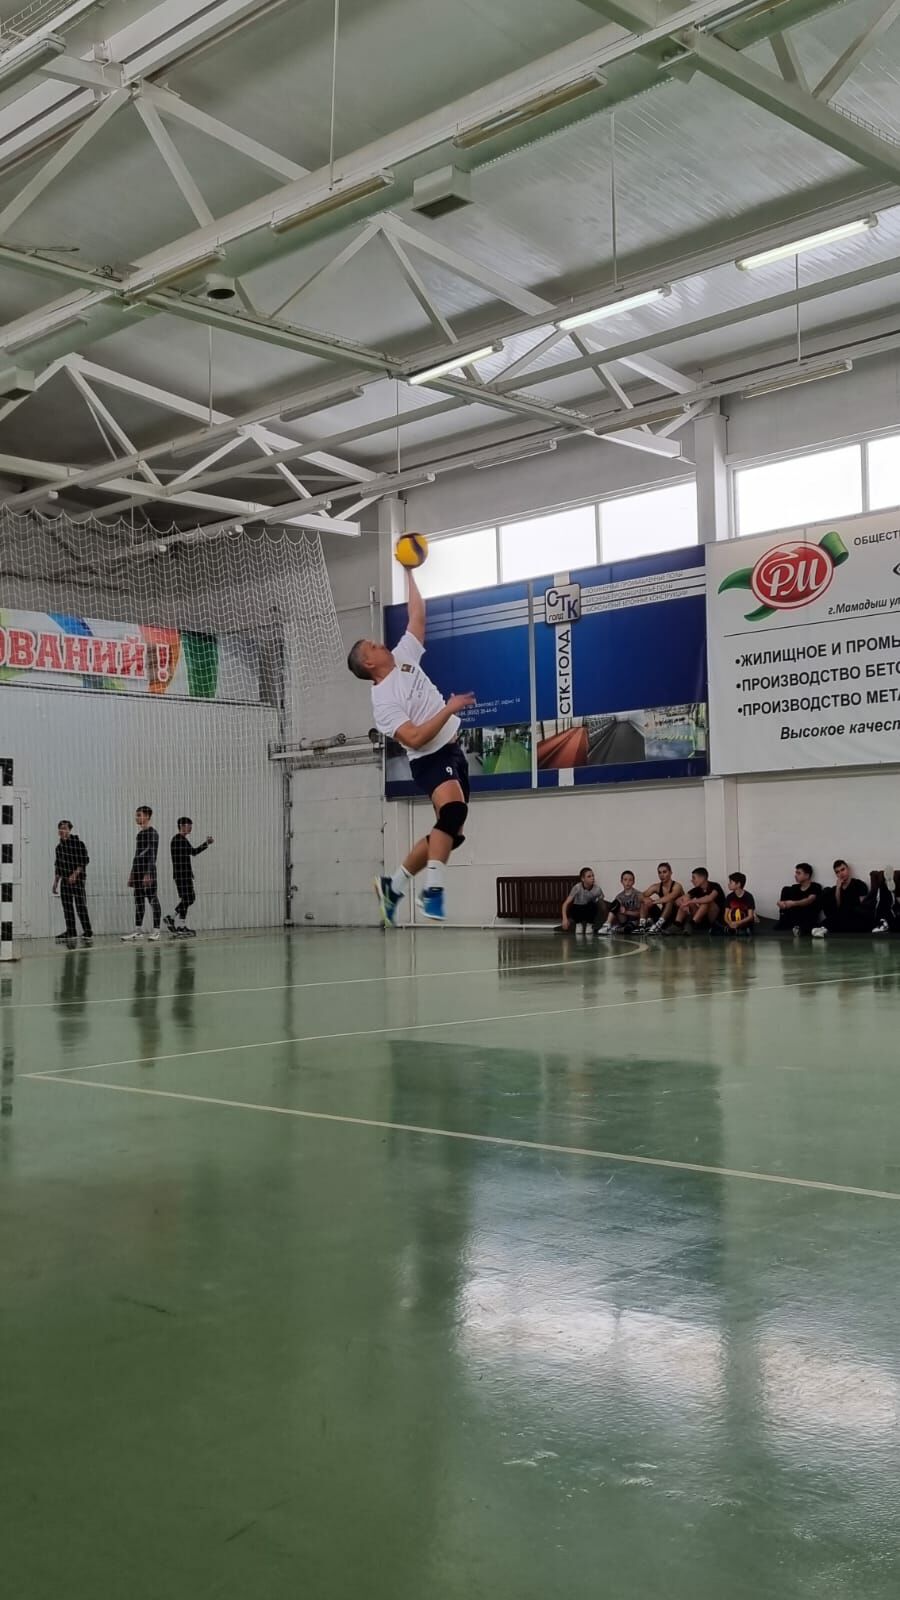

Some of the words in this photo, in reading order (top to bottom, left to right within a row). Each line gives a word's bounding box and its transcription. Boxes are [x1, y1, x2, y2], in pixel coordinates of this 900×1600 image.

[854, 530, 900, 546] ОБЩЕСТ
[547, 590, 578, 618] СТК
[828, 597, 887, 615] г.Мамадыш
[156, 643, 170, 682] !
[741, 644, 827, 667] ЖИЛИЩНОЕ
[831, 642, 841, 655] И
[558, 629, 571, 714] СТК-ГОЛД
[742, 666, 861, 691] ПРОИЗВОДСТВО
[743, 692, 862, 716] ПРОИЗВОДСТВО
[867, 688, 900, 704] МЕТ
[780, 724, 845, 740] Высокое
[445, 766, 453, 776] 9
